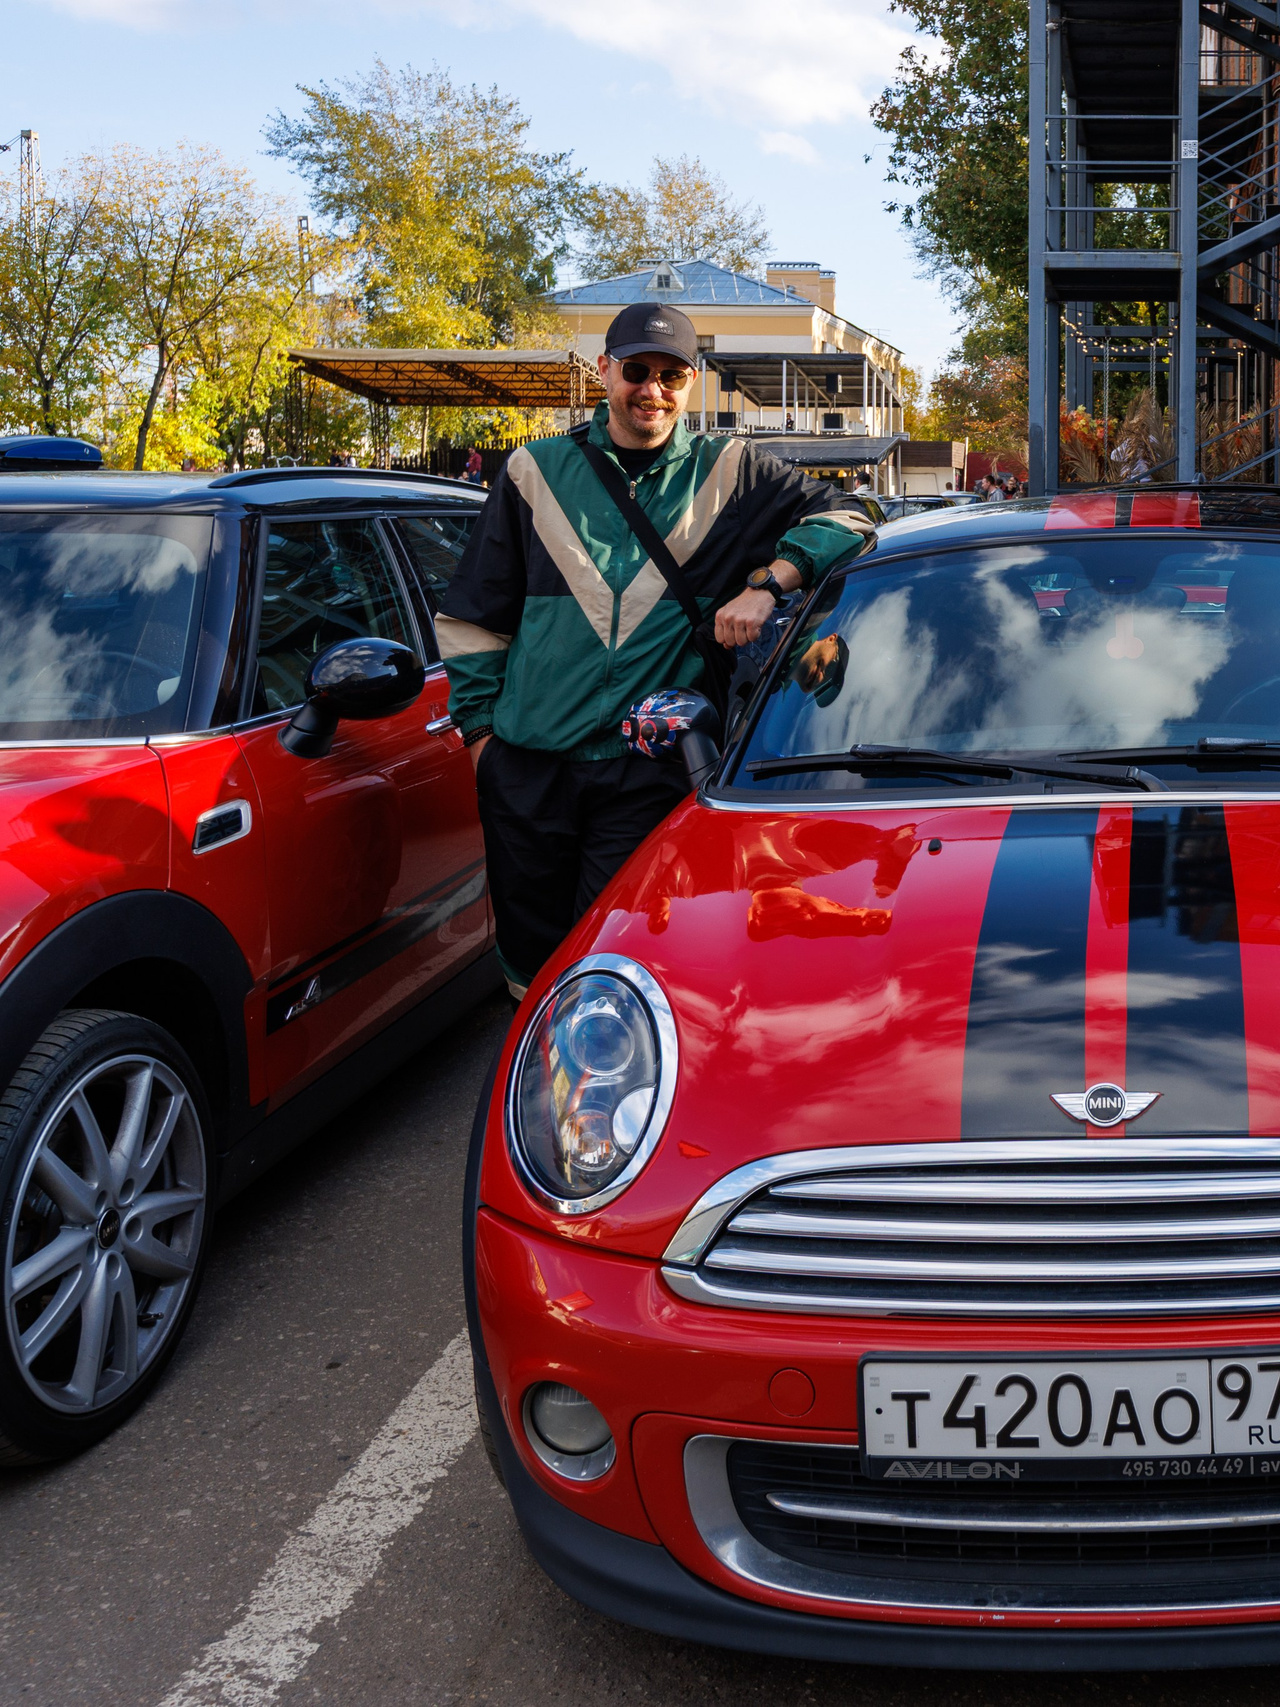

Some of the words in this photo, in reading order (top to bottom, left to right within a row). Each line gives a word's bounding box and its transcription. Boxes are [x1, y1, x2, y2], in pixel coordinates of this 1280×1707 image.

[1089, 1096, 1122, 1110] MINI
[882, 1460, 1021, 1480] AVILON
[1121, 1460, 1155, 1478] 495
[1158, 1459, 1192, 1477] 730
[1195, 1458, 1218, 1475] 44
[1222, 1457, 1244, 1475] 49
